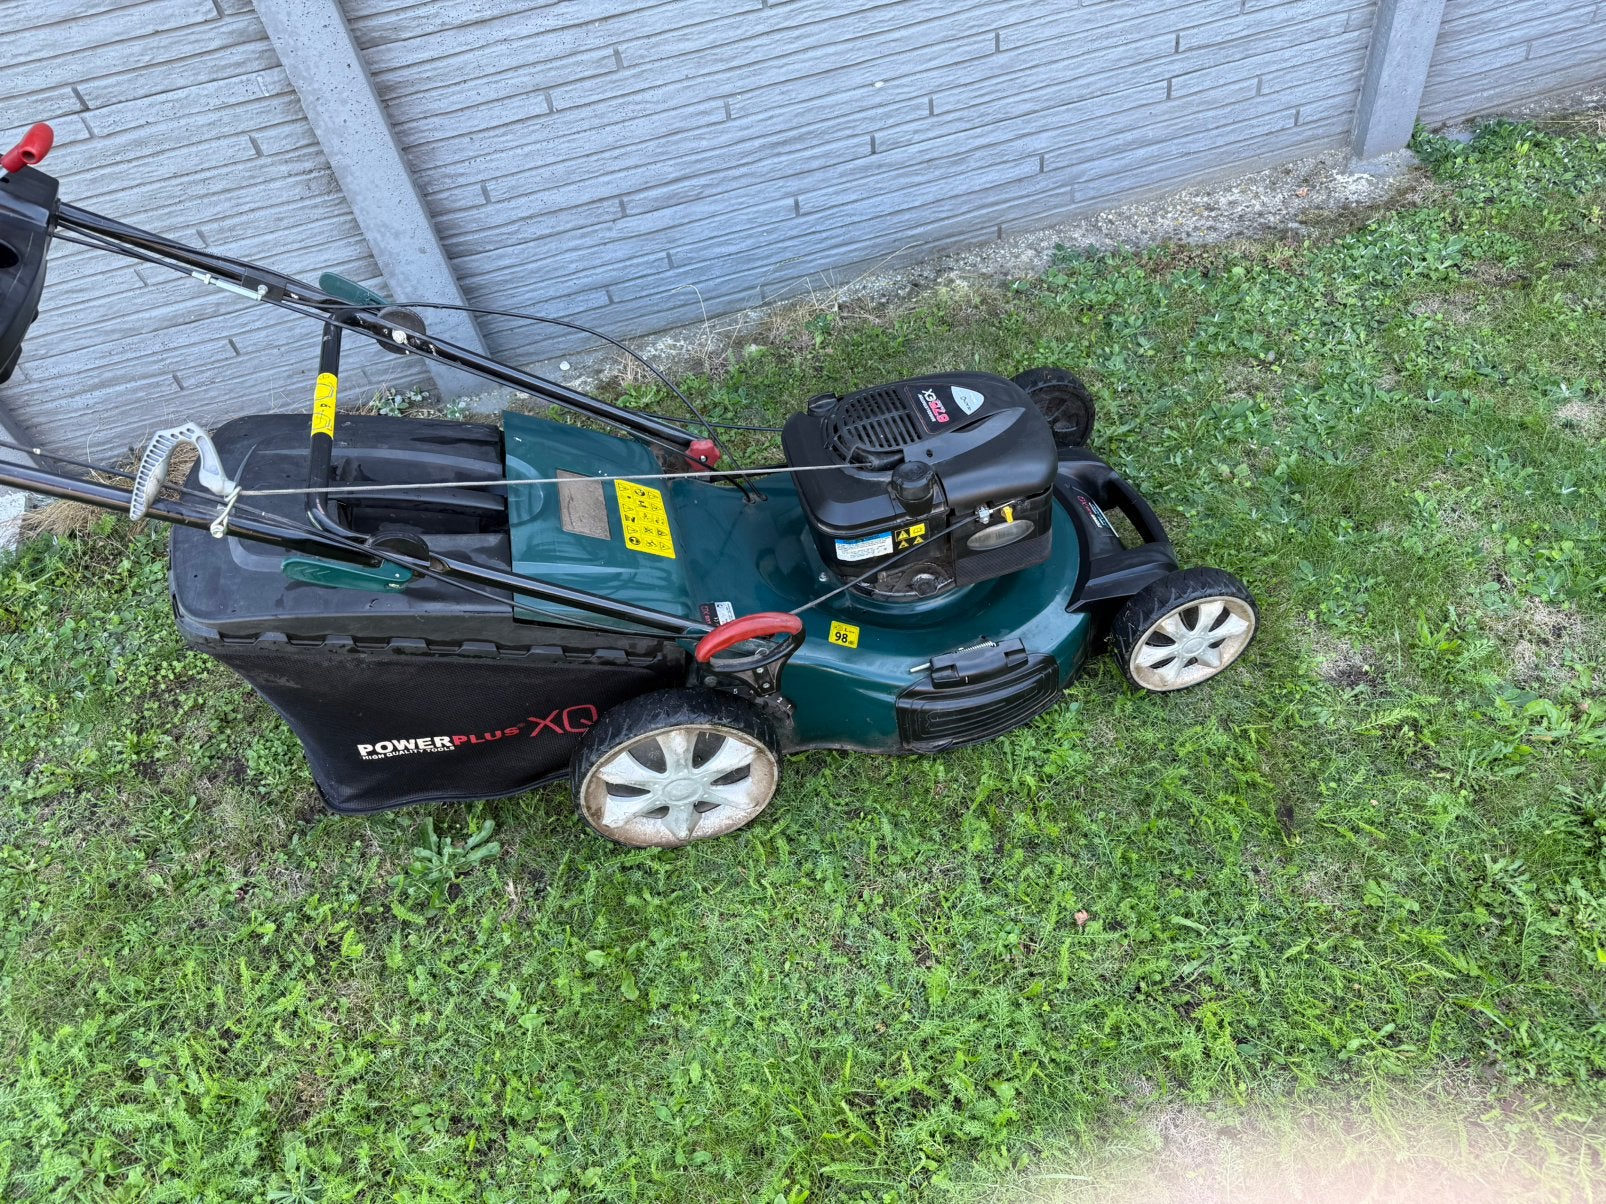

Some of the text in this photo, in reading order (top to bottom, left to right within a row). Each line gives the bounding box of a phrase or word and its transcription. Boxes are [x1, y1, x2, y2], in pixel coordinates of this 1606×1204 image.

[835, 631, 848, 643] 98
[527, 704, 598, 738] XQ
[362, 745, 455, 761] HIGH QUALITY TOOLS
